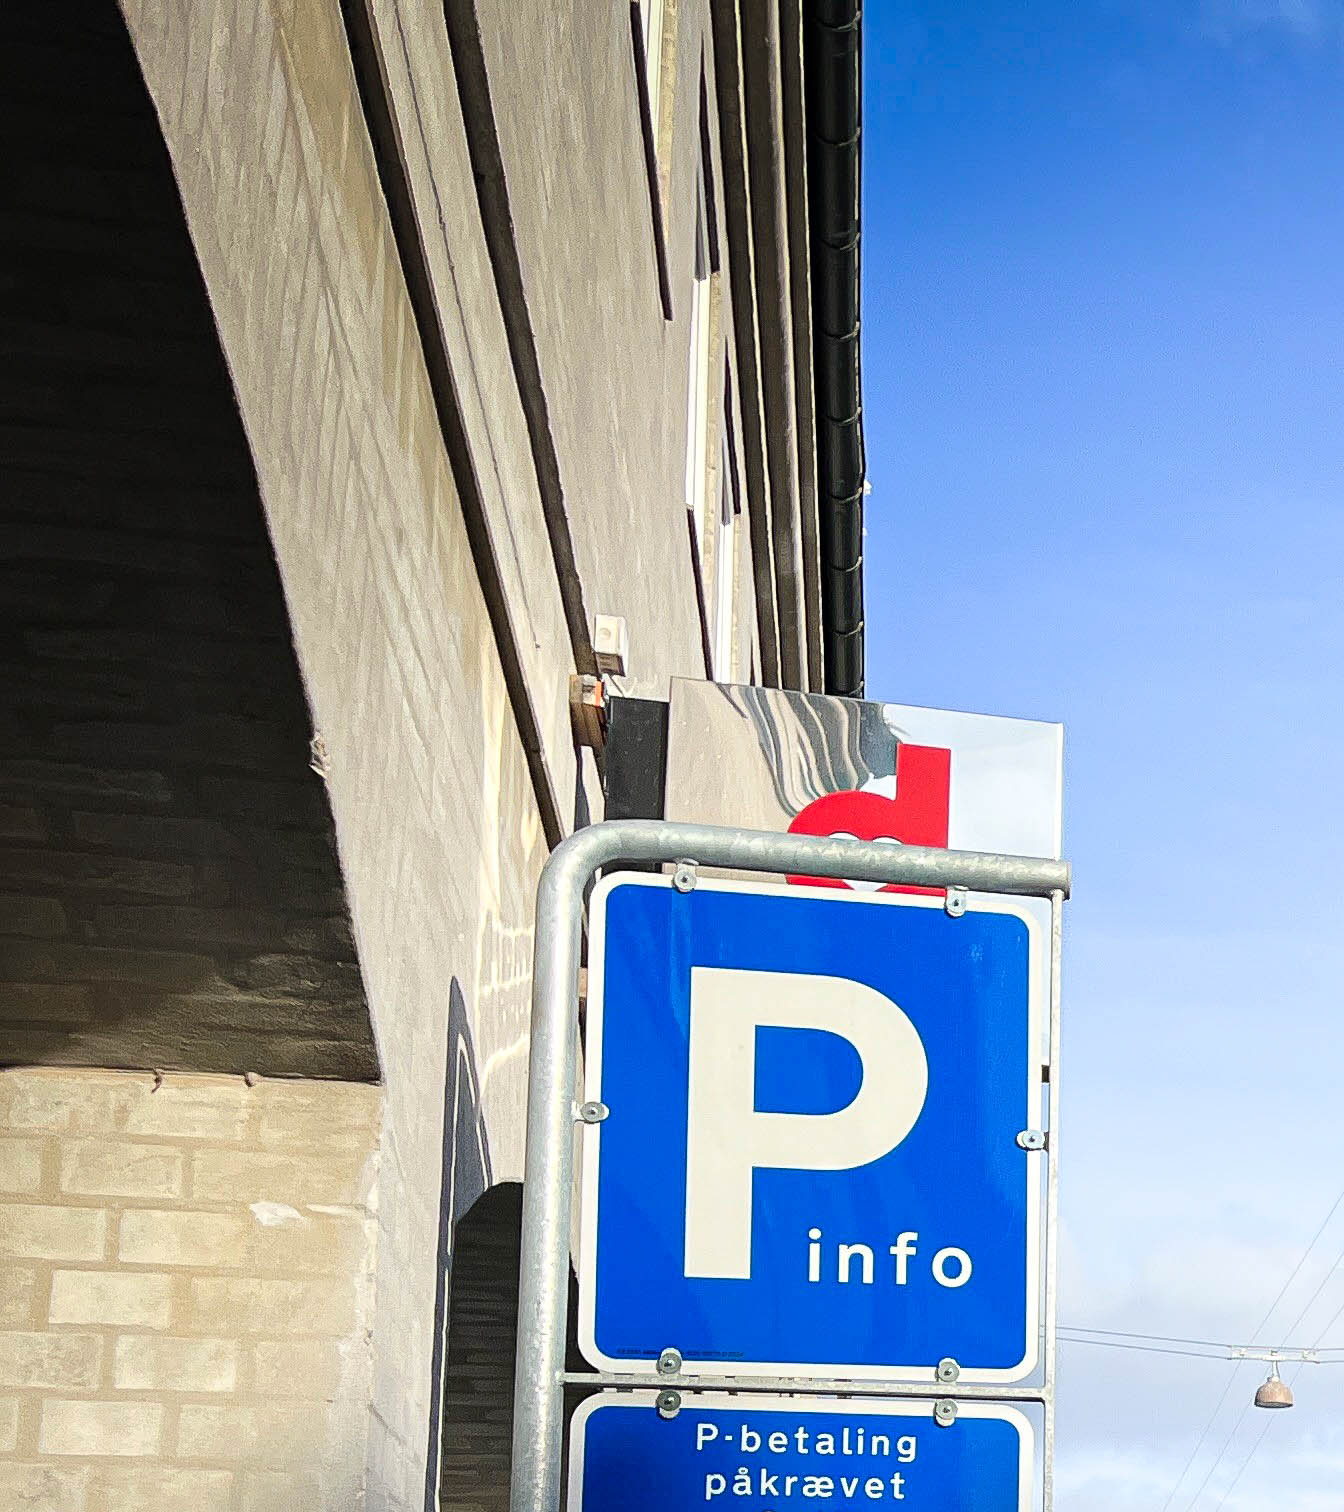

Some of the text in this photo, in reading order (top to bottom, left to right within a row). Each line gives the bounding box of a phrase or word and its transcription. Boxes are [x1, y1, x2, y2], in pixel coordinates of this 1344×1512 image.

[684, 967, 928, 1279] P
[809, 1229, 973, 1287] info
[697, 1424, 916, 1462] P-betaling
[706, 1467, 905, 1500] påkrævet
